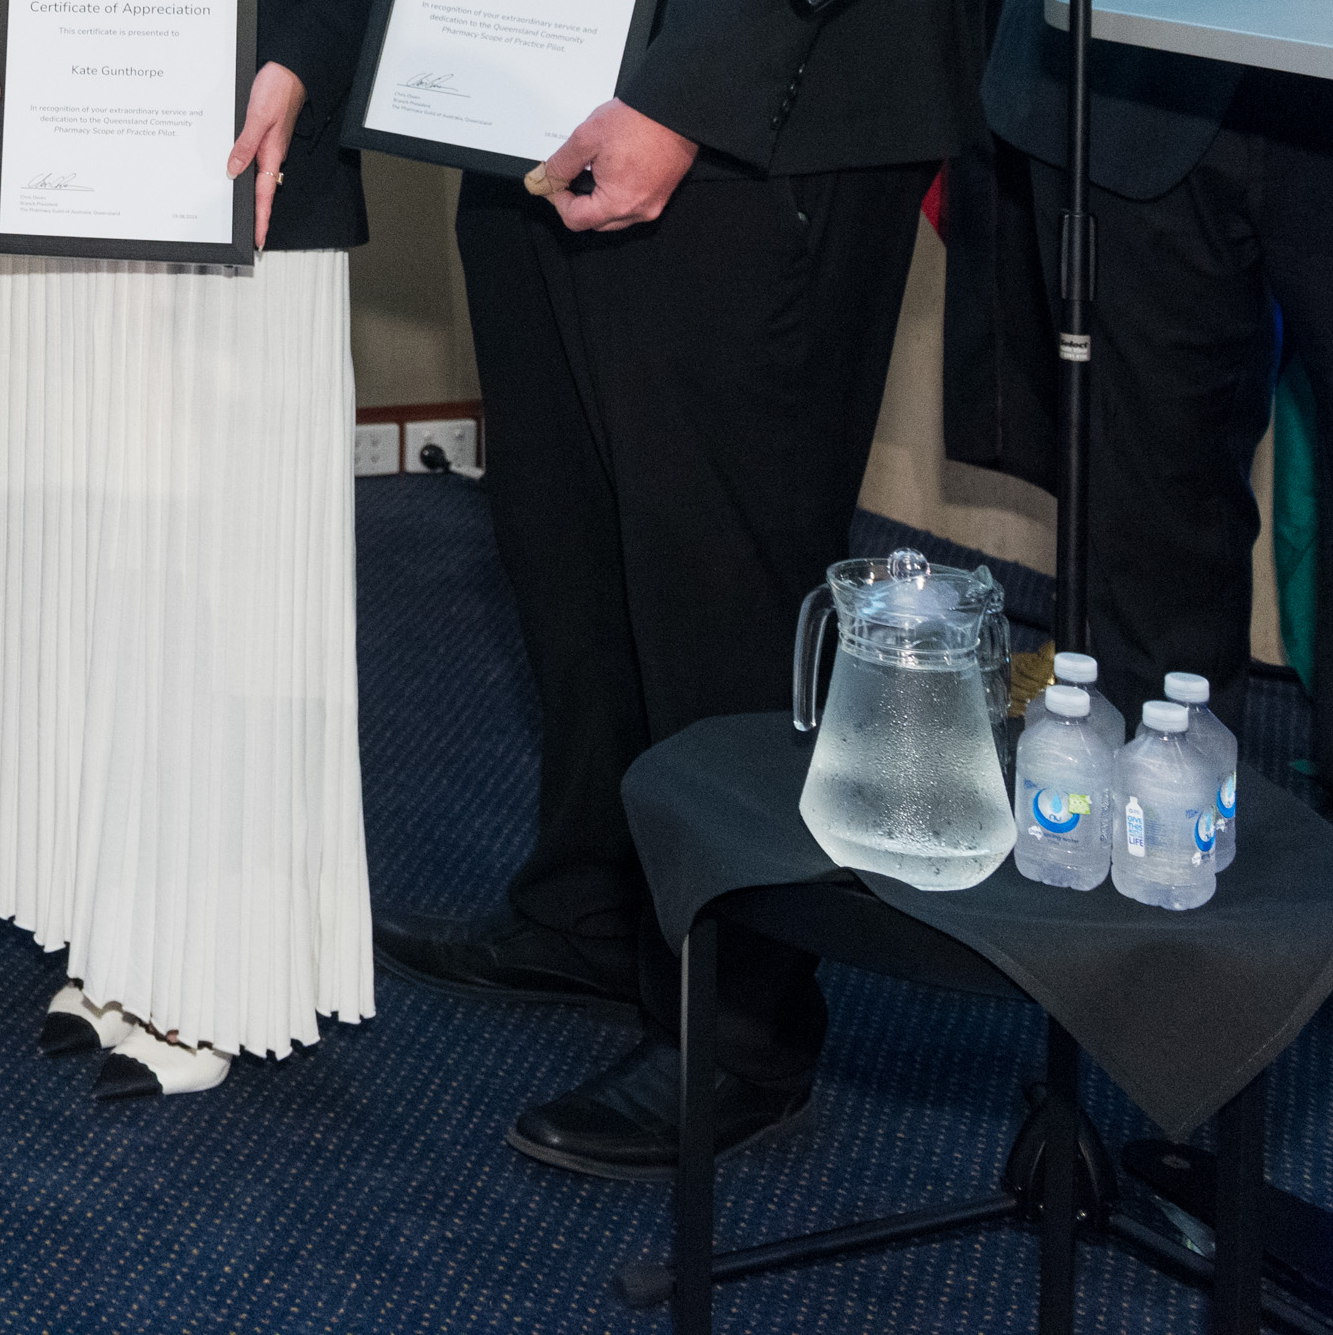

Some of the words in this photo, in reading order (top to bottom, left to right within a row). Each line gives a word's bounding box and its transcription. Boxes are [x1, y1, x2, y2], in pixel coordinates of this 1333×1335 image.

[30, 1, 100, 13] Certificate
[104, 2, 118, 14] of
[122, 3, 210, 16] Appreciation
[430, 3, 472, 15] recognition
[501, 15, 553, 28] extraordinary
[554, 23, 581, 32] service
[582, 27, 598, 35] and
[59, 27, 75, 35] This
[77, 28, 117, 36] certificate
[429, 13, 468, 25] dedication
[479, 21, 492, 29] the
[493, 23, 539, 37] Queensland
[540, 31, 584, 44] Community
[441, 26, 479, 39] Pharmacy
[480, 32, 503, 42] Scope
[514, 37, 545, 49] Practice
[71, 65, 98, 75] Kate
[101, 66, 164, 79] Gunthorpe
[109, 107, 159, 116] extraordinary
[39, 115, 78, 123] dedication
[103, 117, 148, 125] Queensland
[149, 118, 193, 127] Community
[54, 126, 91, 135] Pharmacy
[92, 127, 115, 135] Scope
[126, 128, 156, 136] Practice
[1127, 815, 1142, 824] GIVE
[1128, 822, 1143, 831] THIS
[1129, 837, 1144, 847] LIFE
